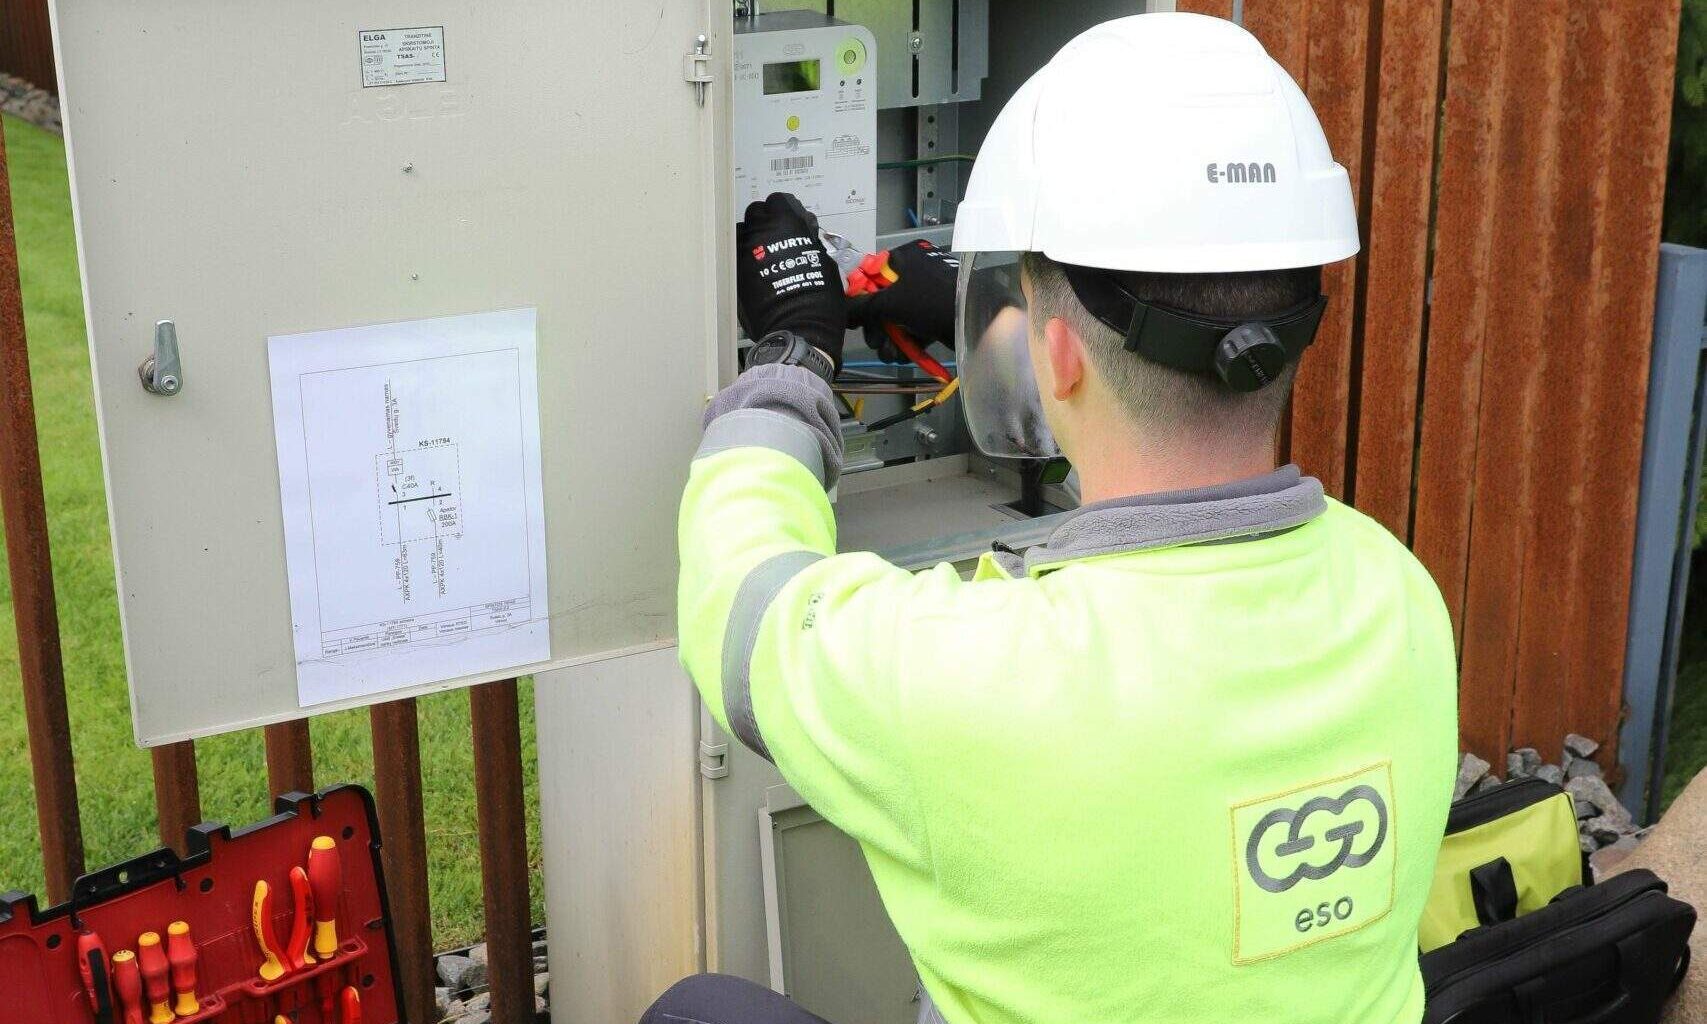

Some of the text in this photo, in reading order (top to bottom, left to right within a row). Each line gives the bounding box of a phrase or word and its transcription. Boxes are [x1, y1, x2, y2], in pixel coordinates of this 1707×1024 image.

[1206, 162, 1276, 183] E-MAN
[760, 268, 769, 277] 10
[772, 271, 823, 289] TIGERFLEX COOL
[1295, 896, 1353, 932] eso
